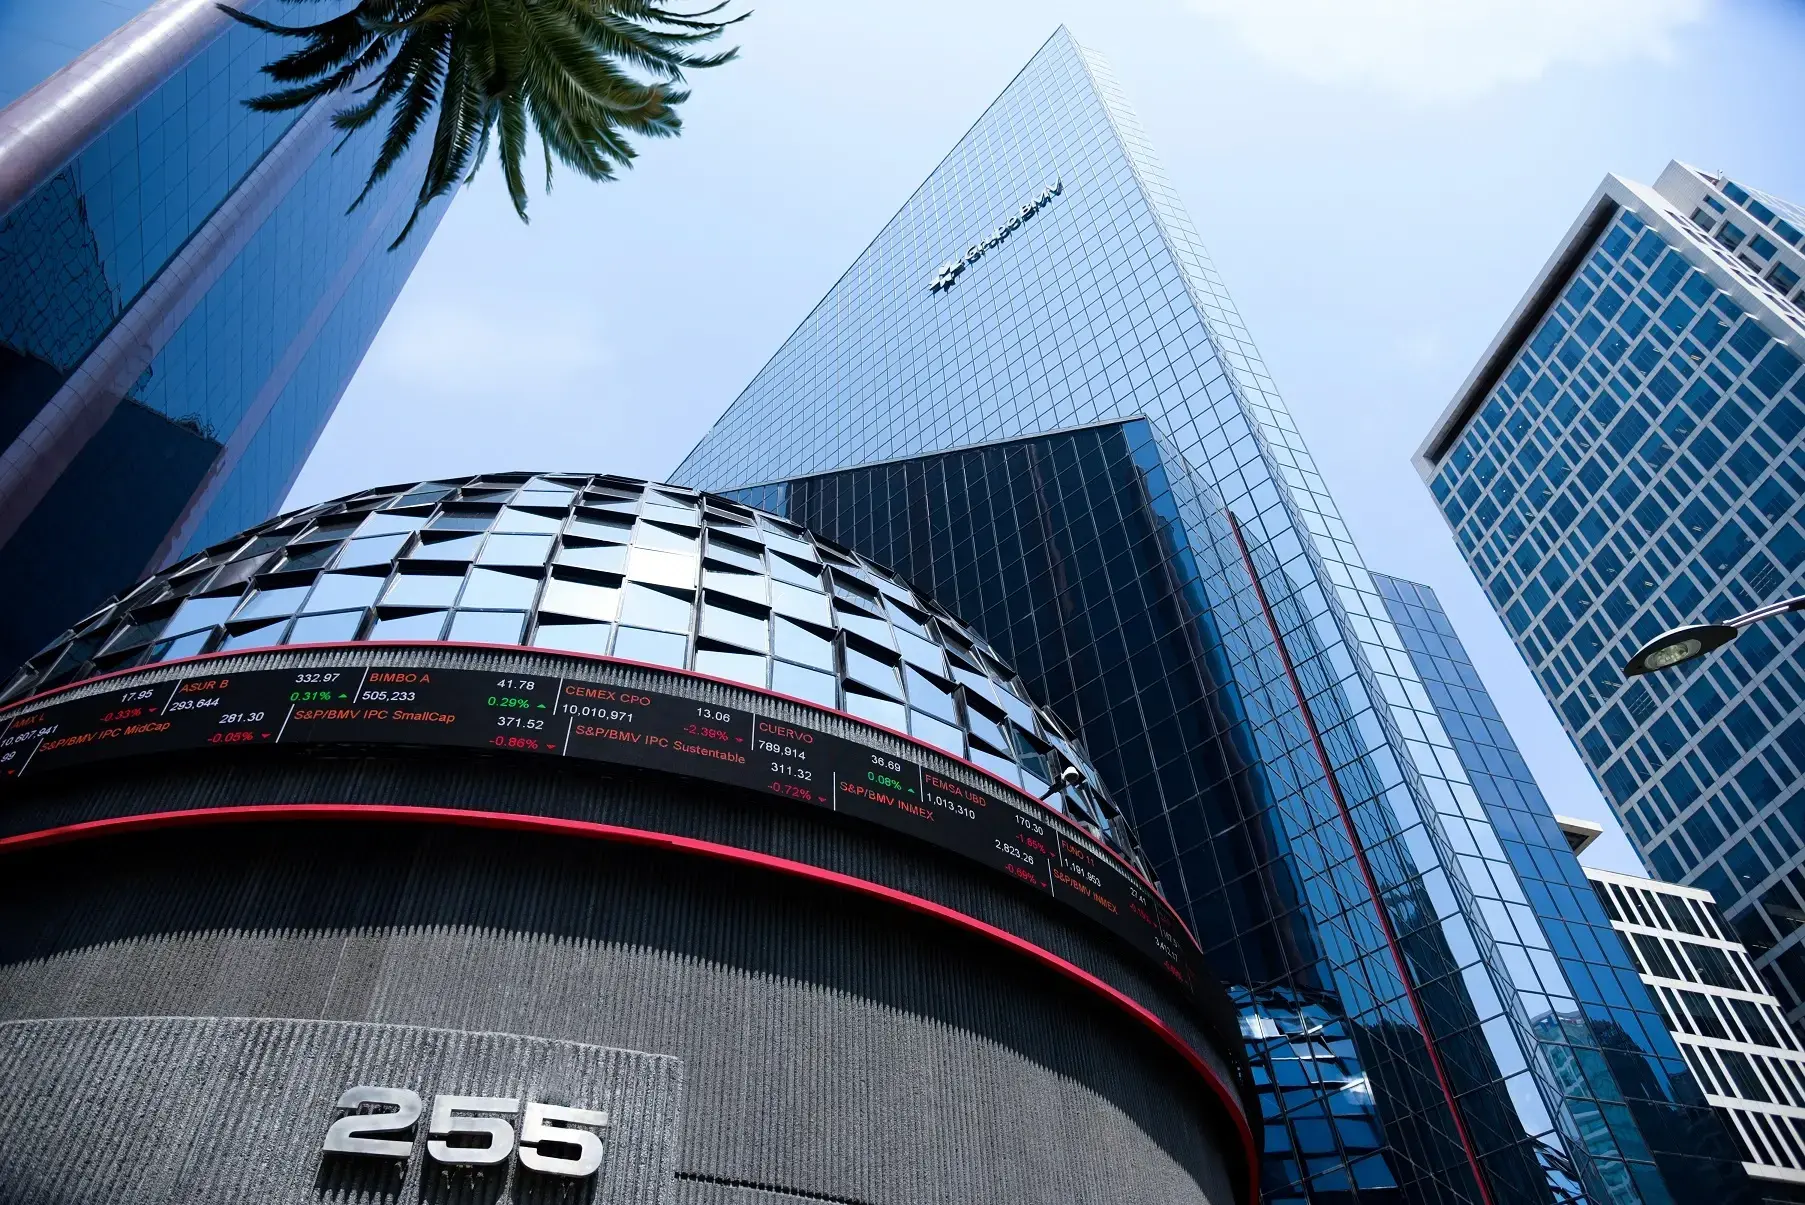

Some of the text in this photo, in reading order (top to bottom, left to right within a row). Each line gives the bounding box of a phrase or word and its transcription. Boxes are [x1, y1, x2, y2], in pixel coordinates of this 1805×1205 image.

[179, 679, 229, 694] ASUR B
[295, 673, 340, 684] 332.97
[369, 672, 431, 684] BIMBO A
[497, 679, 535, 691] 41.78
[121, 689, 154, 703] 17.95
[169, 697, 220, 712] 293,644
[290, 691, 332, 702] 0.31%
[362, 691, 416, 702] 505,233
[488, 696, 531, 709] 0.29%
[565, 685, 651, 707] CEMEX CPO
[100, 708, 143, 722] -0.33%
[219, 711, 265, 724] 281.30
[294, 710, 456, 724] S&P/BMV IPC SmallCap
[562, 704, 634, 723] 10,010,971
[697, 707, 731, 723] 13.06
[497, 716, 544, 730] 371.52
[39, 721, 171, 752] S&P/BMV IPC MidCap
[208, 731, 254, 744] -0.05%
[759, 722, 814, 744] CUERVO
[488, 736, 539, 750] -0.86%
[575, 725, 746, 764] S&P/BMV IPC Sustentable
[758, 739, 807, 761] 789,914
[771, 762, 812, 781] 311.32
[871, 754, 902, 772] 36.69
[867, 771, 903, 791] 0.08%
[767, 781, 812, 801] -0.72%
[925, 773, 987, 808] FEMSA UBD
[839, 781, 936, 822] S&P/BMV INMEX
[926, 792, 977, 820] 1,013,310
[1015, 814, 1044, 836] 170.30
[994, 839, 1034, 865] 2,823.26
[1061, 840, 1096, 867] FUNO 11
[1053, 868, 1119, 915] S&P/BMV INMEX
[322, 1085, 609, 1178] 255
